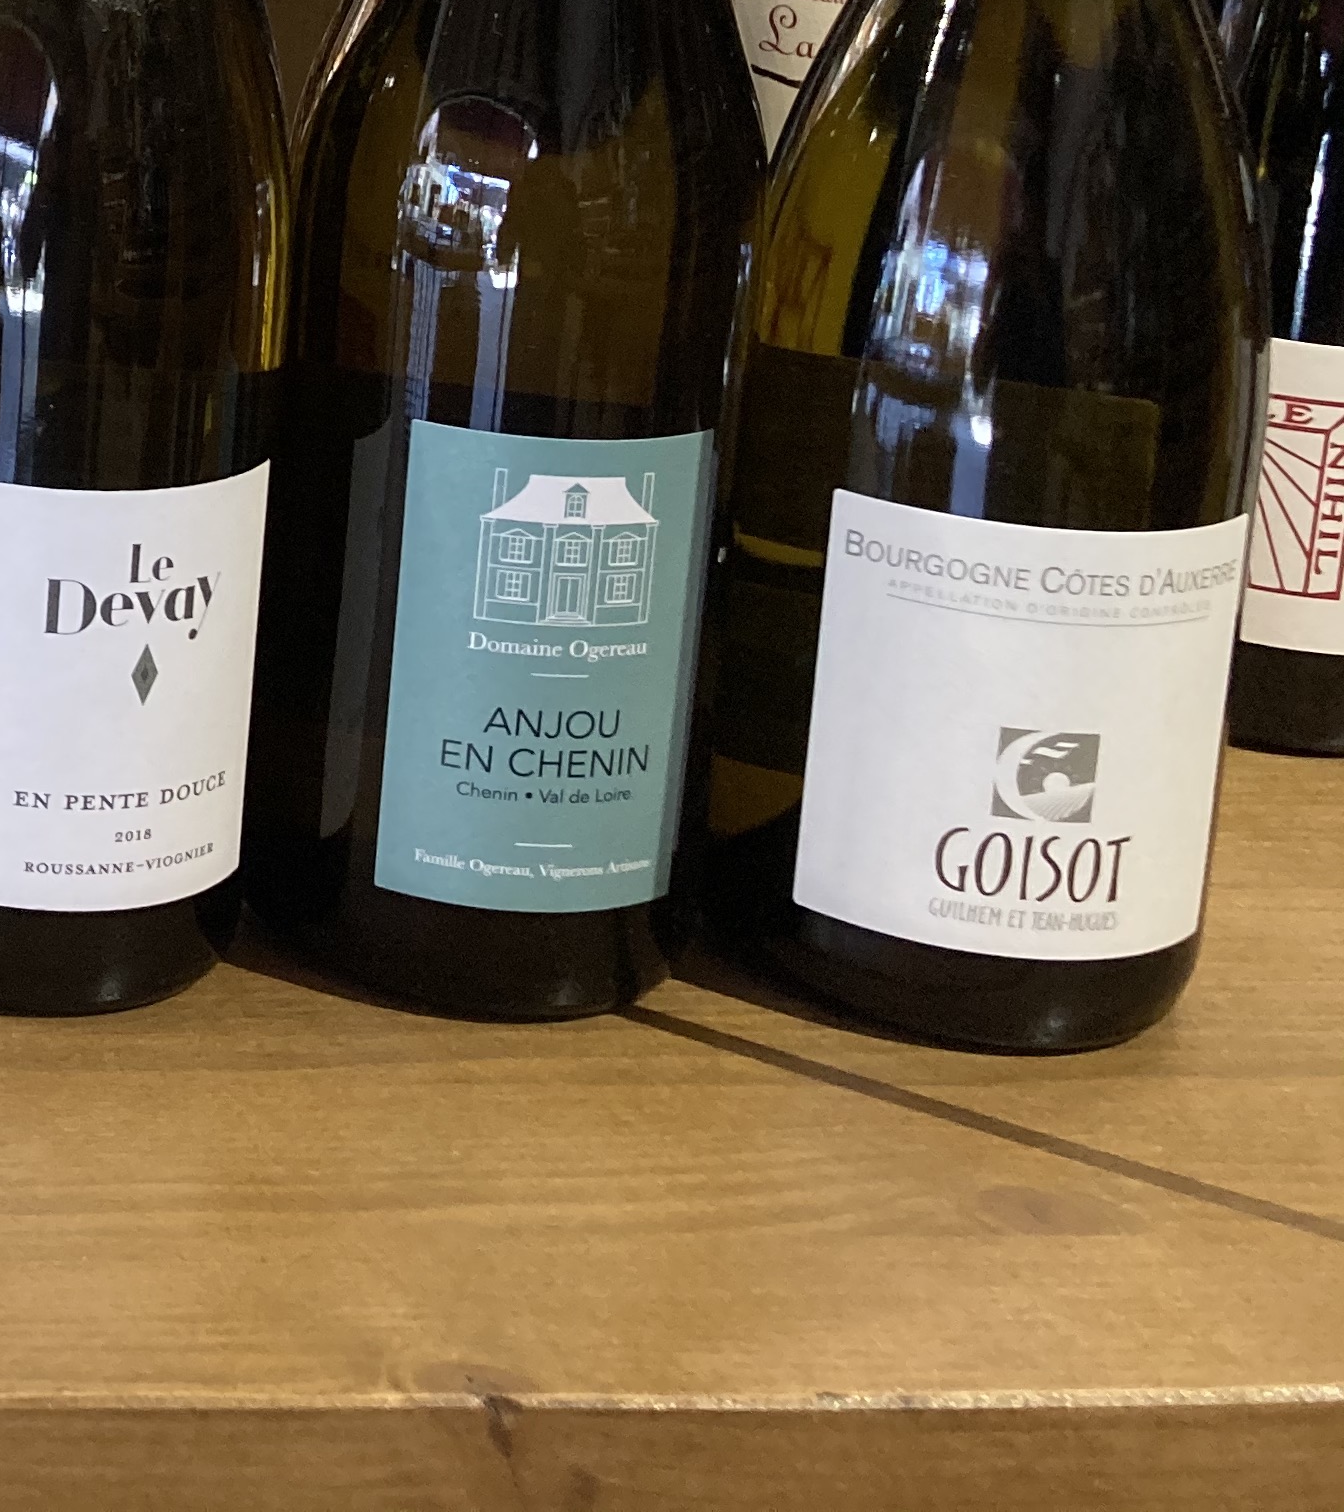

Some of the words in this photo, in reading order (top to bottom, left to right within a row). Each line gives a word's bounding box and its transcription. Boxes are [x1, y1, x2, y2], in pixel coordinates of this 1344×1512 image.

[129, 543, 175, 584] Le
[844, 528, 1032, 592] BOURGOGNE
[1040, 565, 1131, 597] CÔTES
[43, 571, 222, 641] Devay
[887, 577, 1017, 614] APPELLATION
[466, 630, 563, 659] Domaine
[569, 638, 649, 663] Ogereau
[482, 706, 622, 740] ANJOU
[440, 739, 494, 774] EN
[508, 744, 651, 779] CHENIN
[13, 790, 50, 810] EN
[63, 791, 150, 811] PENTE
[160, 770, 227, 806] DOUCE
[456, 780, 519, 803] Chenin
[538, 788, 565, 804] Val
[568, 788, 591, 804] de
[595, 788, 632, 804] Loire
[114, 827, 153, 844] 2018
[24, 842, 215, 875] ROUSSANNE-VIOGNIER
[414, 847, 466, 870] Famille
[934, 825, 1132, 905] GOISOT
[928, 897, 1002, 927] GUILHEM
[1007, 909, 1026, 929] ET
